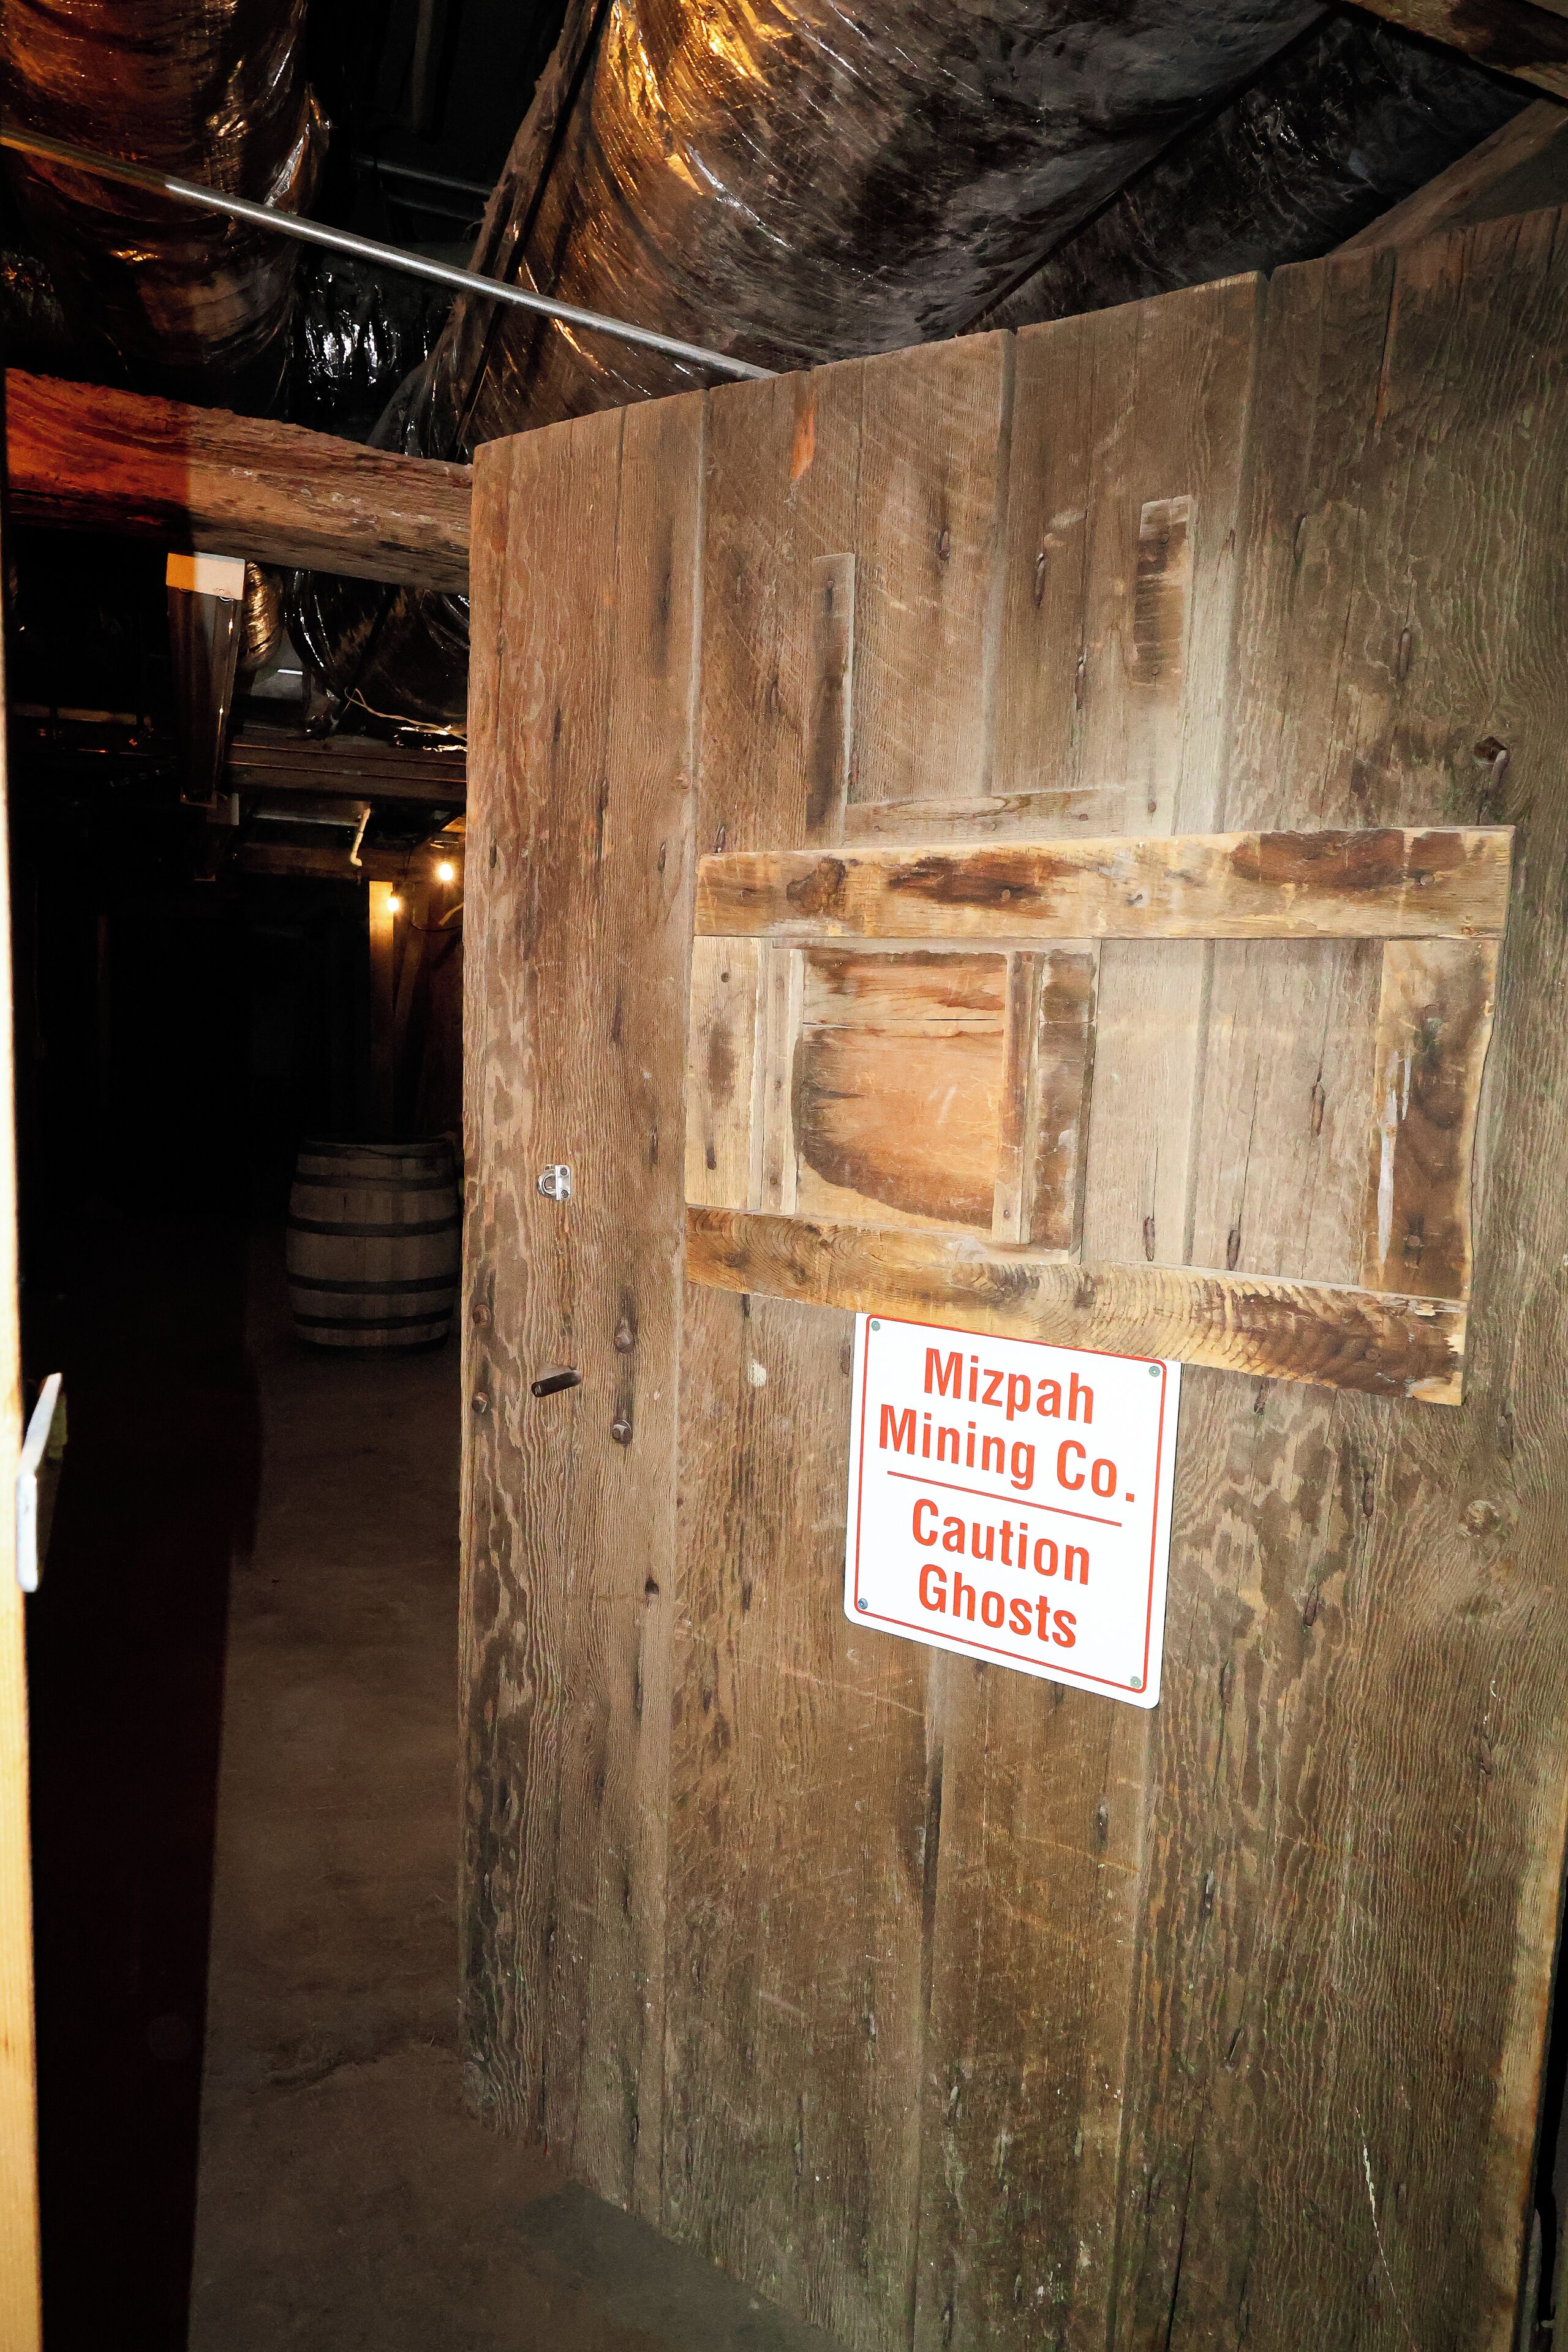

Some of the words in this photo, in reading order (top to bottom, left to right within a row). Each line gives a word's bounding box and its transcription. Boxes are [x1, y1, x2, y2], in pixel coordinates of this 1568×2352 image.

[924, 1347, 1095, 1425] Mizpah
[878, 1403, 1036, 1491] Mining
[1056, 1439, 1136, 1503] Co.
[911, 1498, 1090, 1586] Caution
[918, 1563, 1077, 1648] Ghosts
